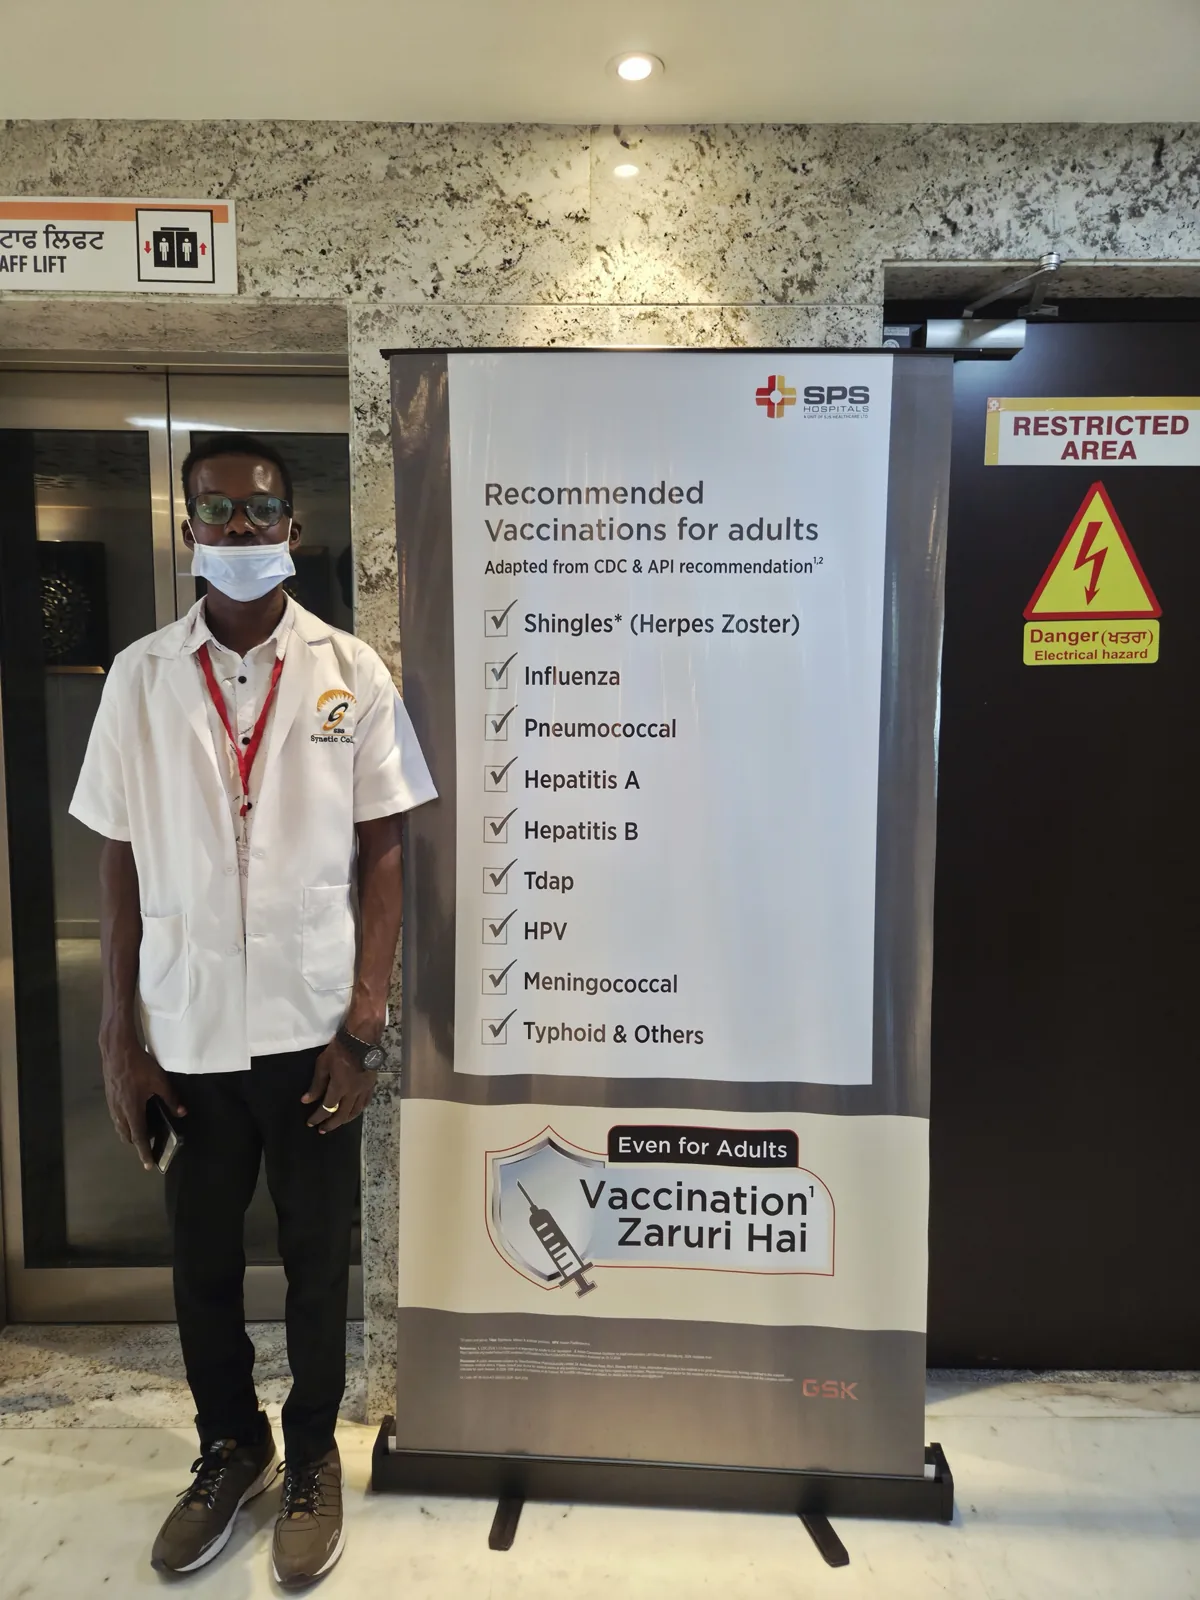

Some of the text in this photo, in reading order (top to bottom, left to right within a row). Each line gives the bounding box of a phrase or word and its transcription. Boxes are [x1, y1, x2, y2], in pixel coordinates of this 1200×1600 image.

[43, 224, 104, 249] ਲਿਫਟ
[0, 255, 67, 273] AFF LIFT
[804, 386, 869, 404] SPS
[1013, 416, 1189, 436] RESTRICTED
[1061, 441, 1137, 460] AREA
[485, 481, 704, 506] Recommended
[485, 517, 819, 542] Vaccinations for adults
[485, 559, 548, 576] Adapted
[553, 559, 589, 574] from
[594, 559, 628, 574] CDC
[632, 560, 643, 574] &
[648, 560, 675, 574] API
[630, 613, 714, 636] (Herpes
[721, 614, 801, 636] Zoster)
[1030, 629, 1099, 646] Danger
[1034, 648, 1148, 661] Electrical hazard
[525, 666, 621, 686] Influenza
[525, 718, 677, 738] Pneumococcal
[310, 735, 338, 744] Synetic
[525, 770, 641, 792] Hepatitis A
[525, 821, 639, 843] Hepatitis B
[524, 871, 575, 894] Tdap
[524, 922, 568, 941] HPV
[524, 972, 678, 995] Meningococcal
[523, 1022, 704, 1045] Typhoid & Others
[618, 1136, 788, 1159] Even for Adults
[618, 1217, 807, 1253] Zaruri Hai
[802, 1378, 859, 1400] GSK
